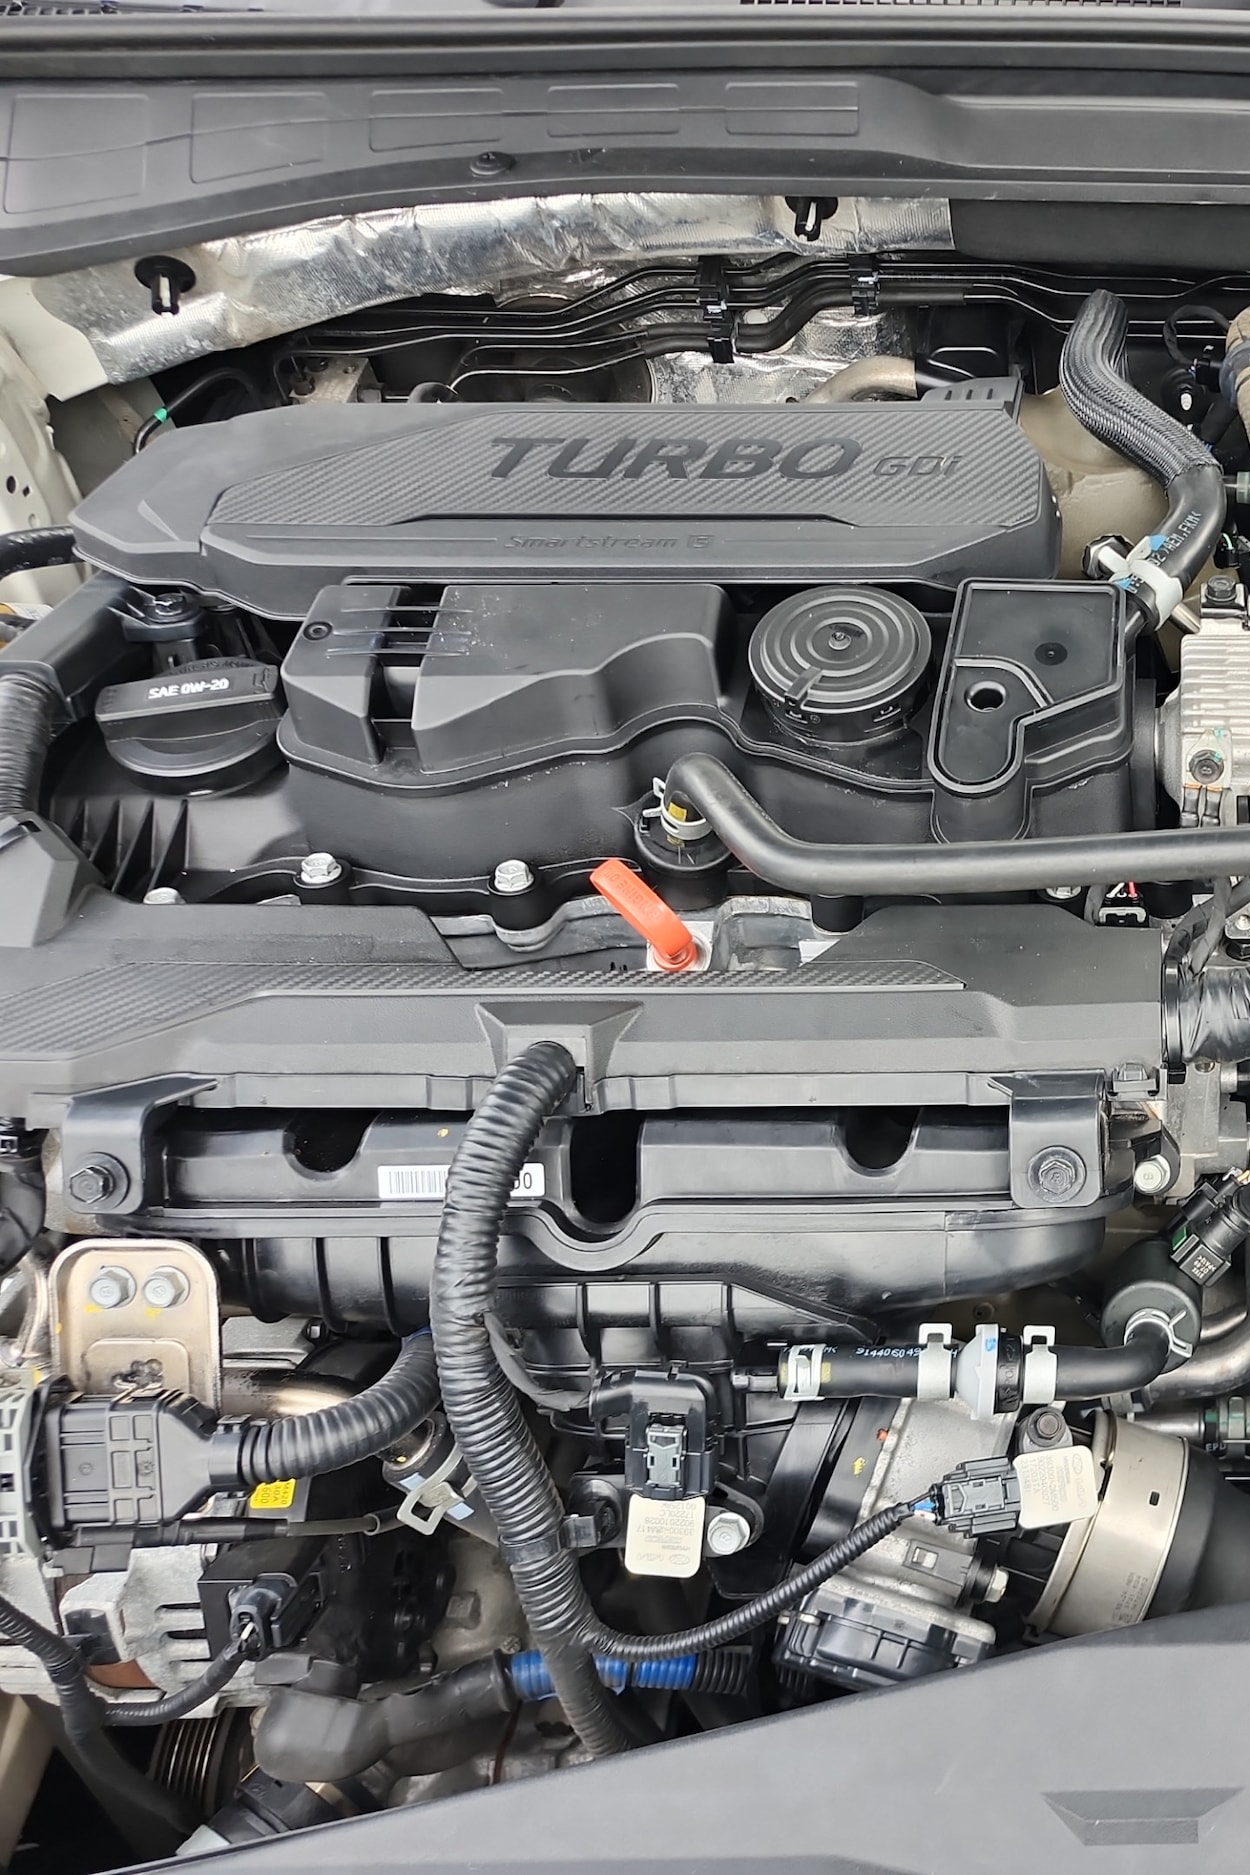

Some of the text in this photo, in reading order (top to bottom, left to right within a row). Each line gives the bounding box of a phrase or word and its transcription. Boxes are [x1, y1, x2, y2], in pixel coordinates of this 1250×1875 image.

[491, 437, 962, 481] TURBO GDi
[504, 534, 677, 549] Smartstream
[148, 677, 230, 699] SAE 0W-20
